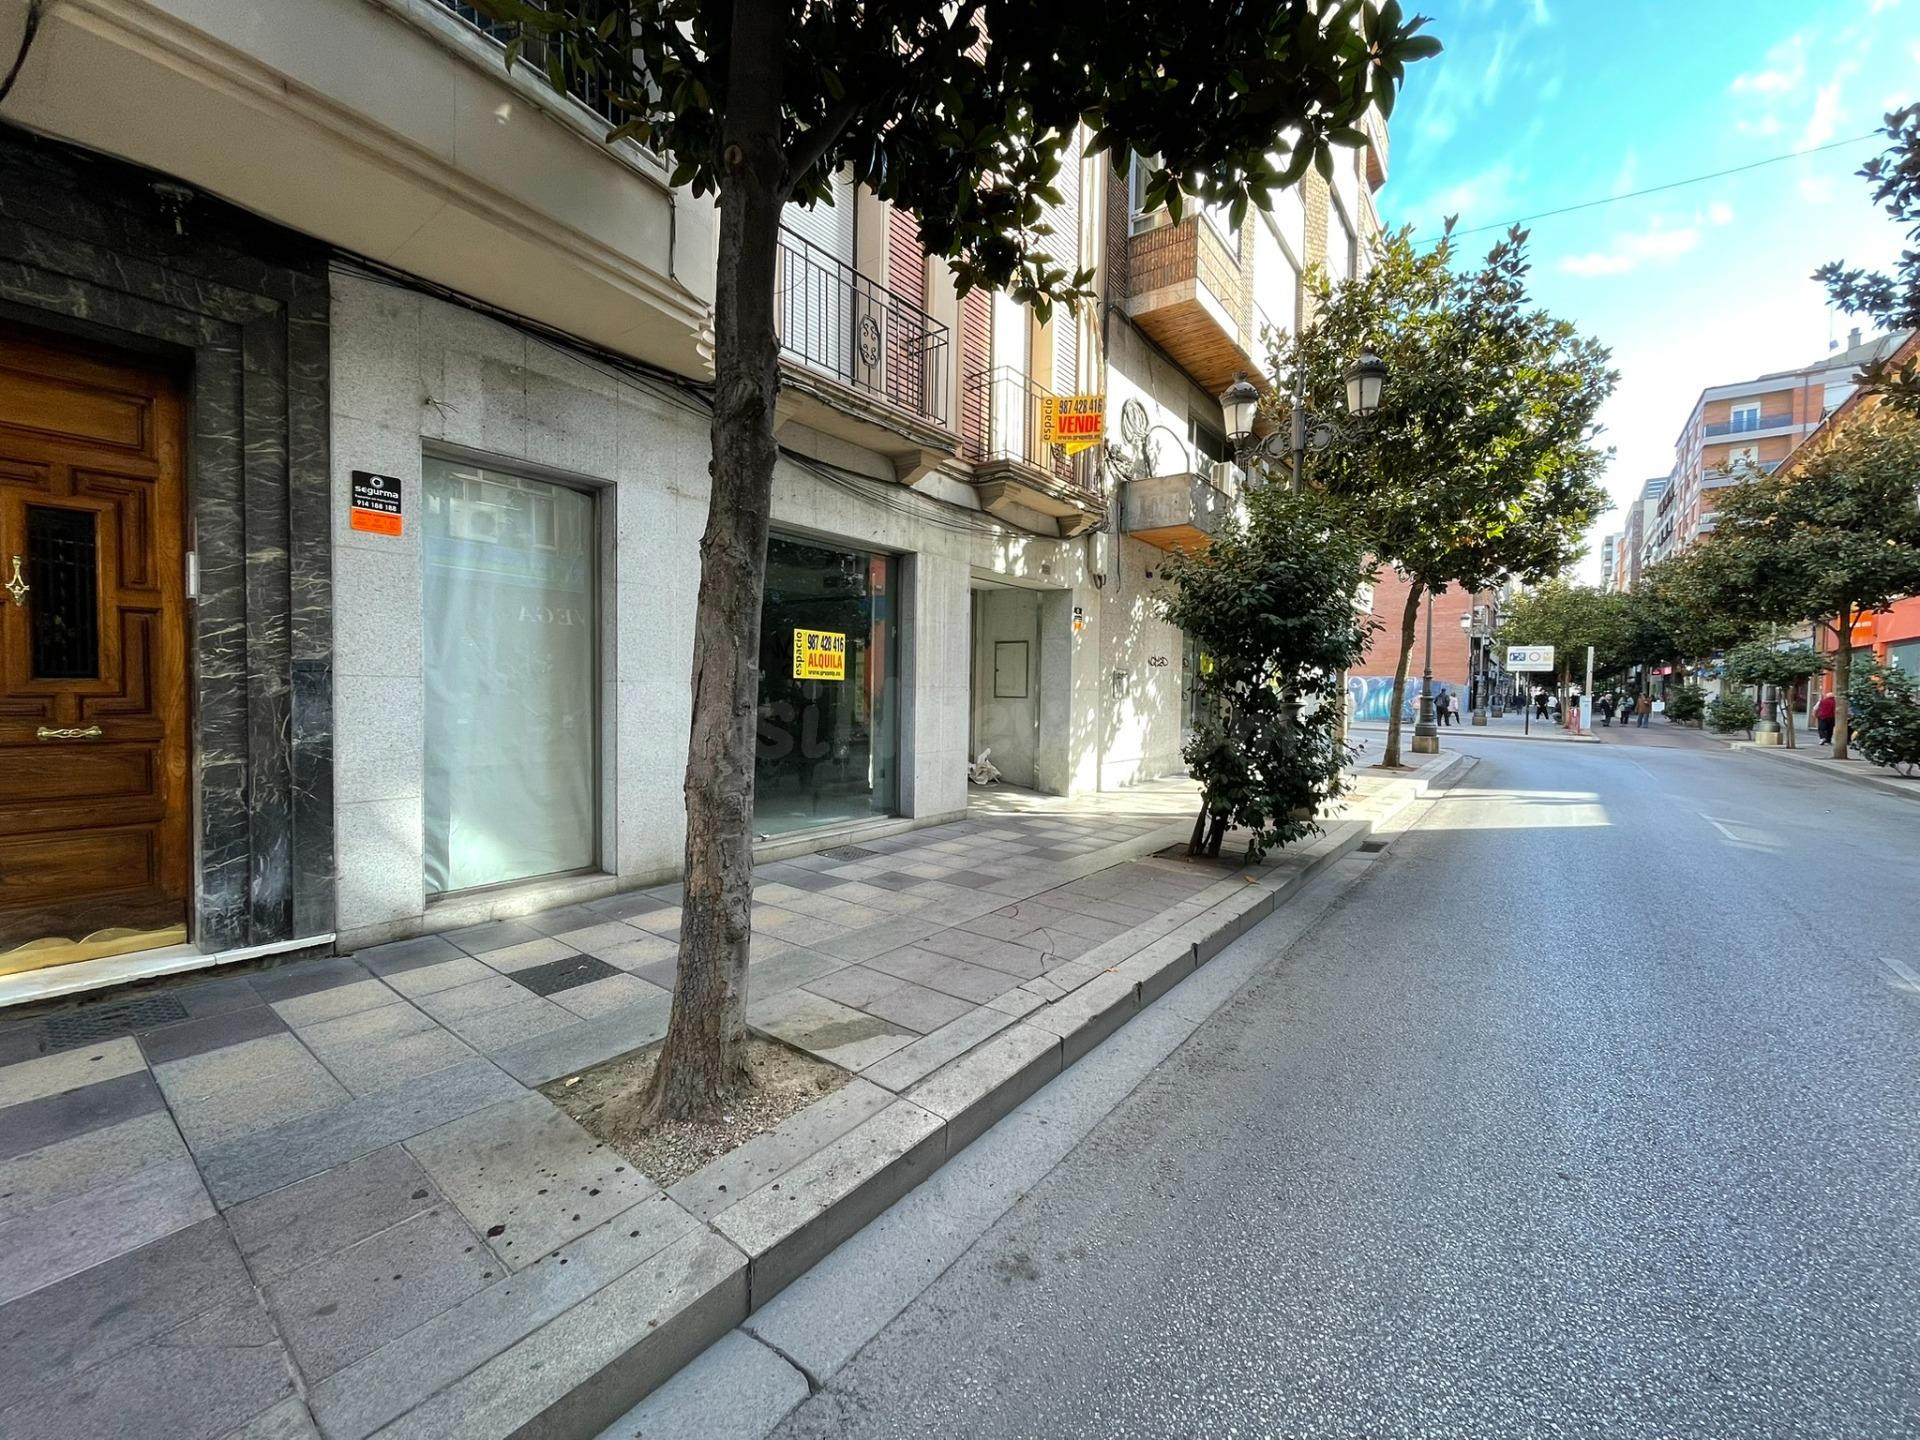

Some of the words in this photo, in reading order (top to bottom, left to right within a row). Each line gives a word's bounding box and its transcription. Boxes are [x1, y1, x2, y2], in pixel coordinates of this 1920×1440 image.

[1059, 400, 1073, 415] 987
[1074, 399, 1088, 414] 428
[1089, 398, 1102, 413] 416
[1043, 399, 1054, 440] espacio
[1058, 415, 1102, 433] VENDE
[354, 485, 399, 499] segurma
[357, 499, 369, 507] 914
[807, 634, 819, 650] 987
[833, 636, 844, 652] 416
[796, 632, 804, 676] espacio
[808, 653, 843, 669] ALQUILA
